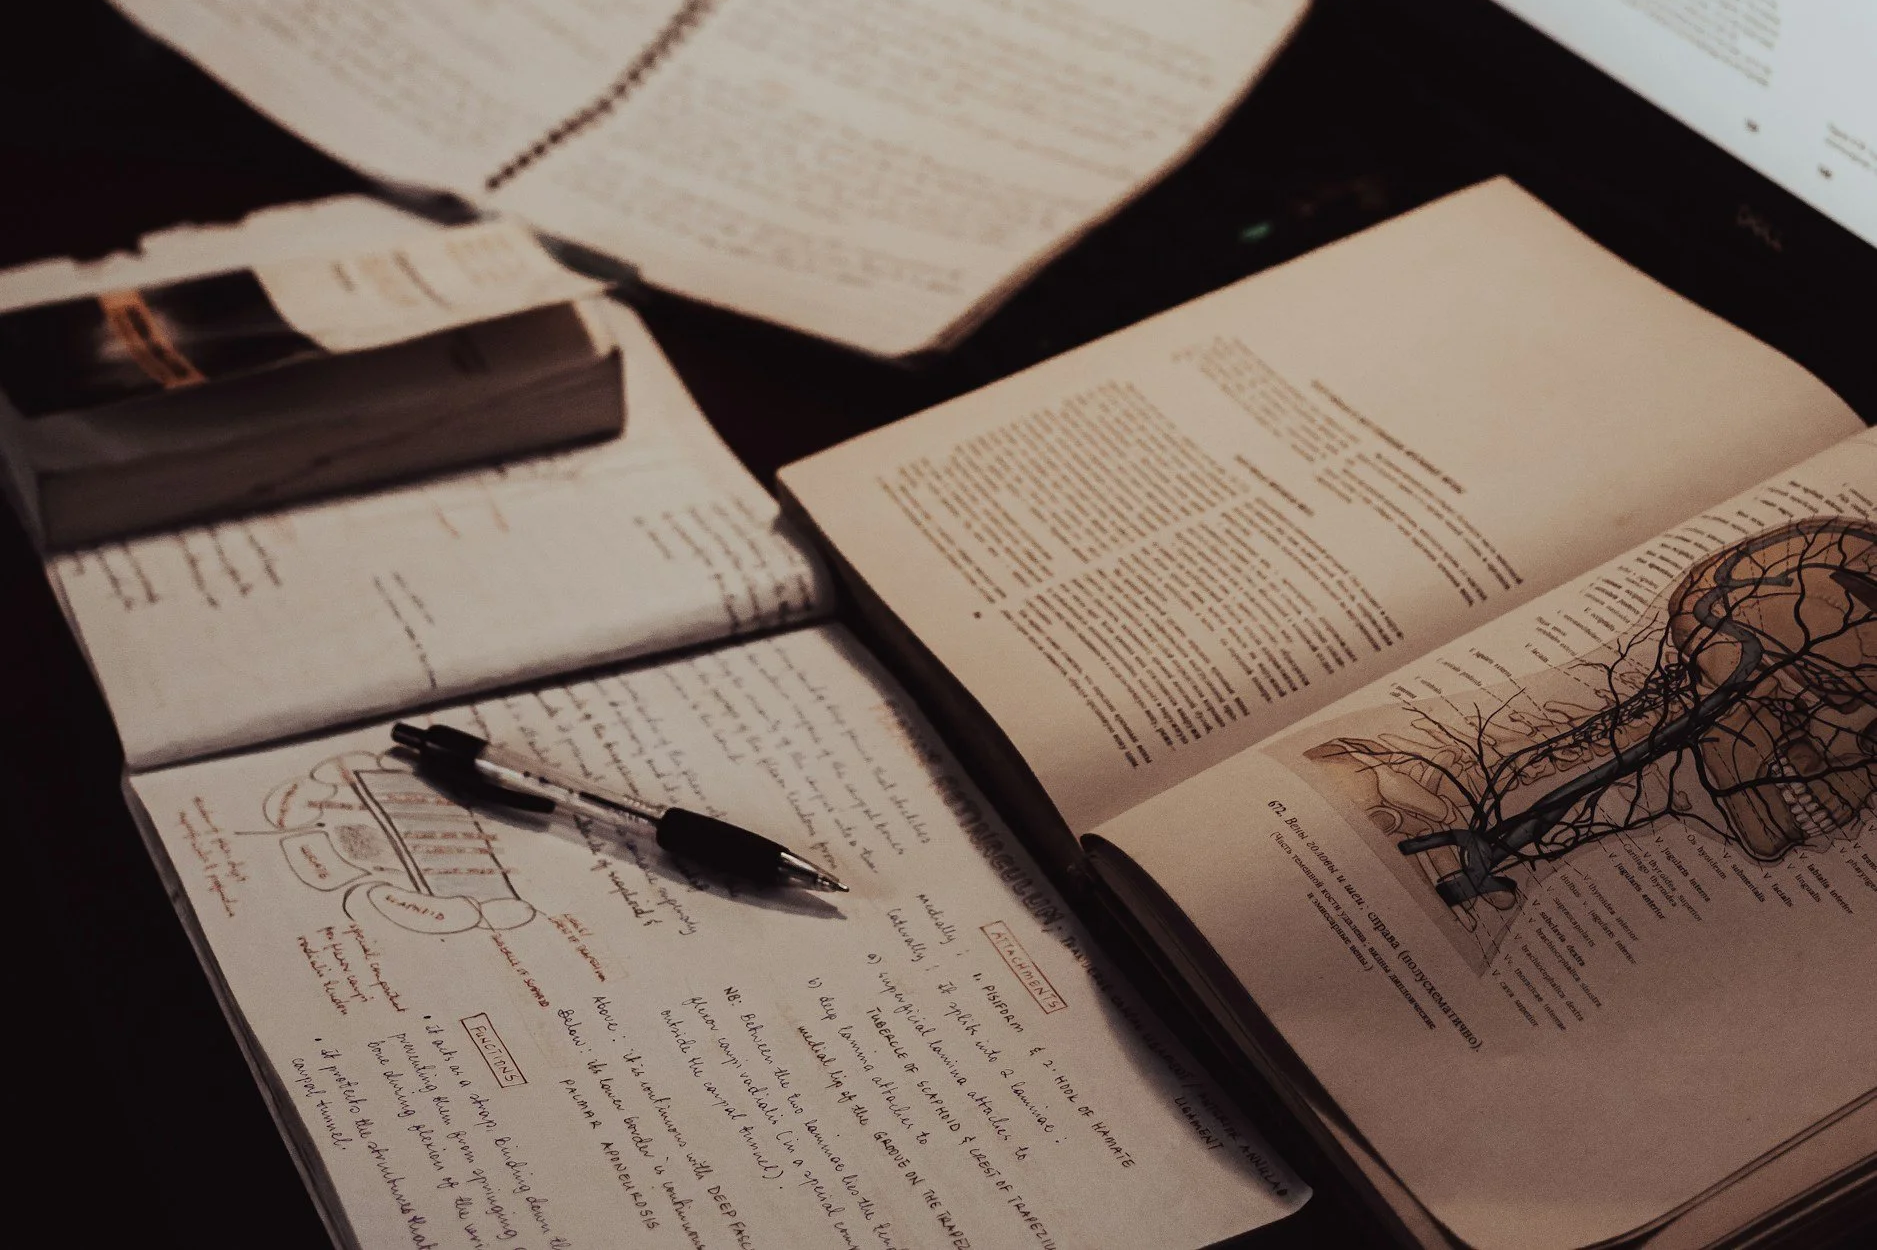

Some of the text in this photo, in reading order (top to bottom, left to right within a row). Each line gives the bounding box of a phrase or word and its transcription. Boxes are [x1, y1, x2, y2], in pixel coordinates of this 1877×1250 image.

[1267, 799, 1287, 817] 672.
[1283, 816, 1308, 840] Вены
[1305, 840, 1339, 874] головы
[1335, 874, 1346, 883] и
[1366, 911, 1400, 950] справа
[1613, 862, 1642, 892] jugularis
[1641, 893, 1665, 920] anterior
[1622, 843, 1677, 907] Cartilago thyroidea
[1647, 858, 1702, 922] thyroidea superior
[1659, 846, 1689, 877] jugularis
[1688, 877, 1711, 902] interna
[1686, 833, 1727, 880] Os hyoideum
[1730, 863, 1765, 903] submentalis
[1269, 830, 1292, 855] (Часть
[1291, 853, 1324, 888] теменной
[1320, 887, 1342, 911] кости
[1367, 945, 1391, 973] видны
[1387, 973, 1436, 1030] диплоические
[1306, 891, 1314, 899] и
[1311, 897, 1351, 945] эмиссарные
[1828, 888, 1853, 914] inferior
[990, 931, 1058, 1014] ATTACHMENTS
[1538, 911, 1585, 967] subclavia dextra
[1499, 981, 1539, 1027] cava superior
[1564, 1000, 1584, 1022] dextra
[472, 1025, 517, 1083] FUNCTIONS
[660, 1009, 696, 1054] outside
[687, 1056, 703, 1078] the
[702, 1081, 746, 1120] carpal
[818, 995, 837, 1020] deep
[837, 1025, 874, 1072] lamina
[915, 1130, 930, 1145] to
[974, 1040, 999, 1062] into
[981, 984, 1024, 1033] PISIFORM
[1054, 1075, 1078, 1103] HOOK
[1077, 1105, 1094, 1117] OF
[1090, 1121, 1135, 1168] HAMATE
[317, 1064, 367, 1113] protects
[354, 1117, 374, 1139] the
[366, 1039, 389, 1066] bone
[382, 1070, 416, 1118] during
[436, 1176, 459, 1189] of
[453, 1195, 473, 1220] the
[598, 1077, 624, 1110] lower
[622, 1116, 654, 1157] border
[739, 1012, 773, 1065] Between
[773, 1066, 790, 1089] the
[786, 1092, 803, 1114] two
[857, 1196, 874, 1221] the
[796, 1025, 836, 1067] medial
[852, 1104, 869, 1126] the
[872, 1131, 910, 1168] GROOVE
[904, 1170, 924, 1186] ON
[922, 1188, 941, 1209] THE
[865, 1006, 1013, 1191] TUBERCLE OF SCAPHOID CREST OF
[928, 1039, 967, 1086] lamina
[1014, 1145, 1029, 1160] to
[1173, 1096, 1224, 1150] LIGAMENT
[388, 1032, 518, 1240] preventing them from springing
[431, 1039, 458, 1062] acts
[524, 1195, 550, 1234] down
[558, 1078, 660, 1229] PALMAR APONEUROSIS
[685, 1153, 713, 1180] with
[706, 1184, 737, 1217] DEEP
[791, 1159, 804, 1167] a
[798, 1169, 845, 1217] special
